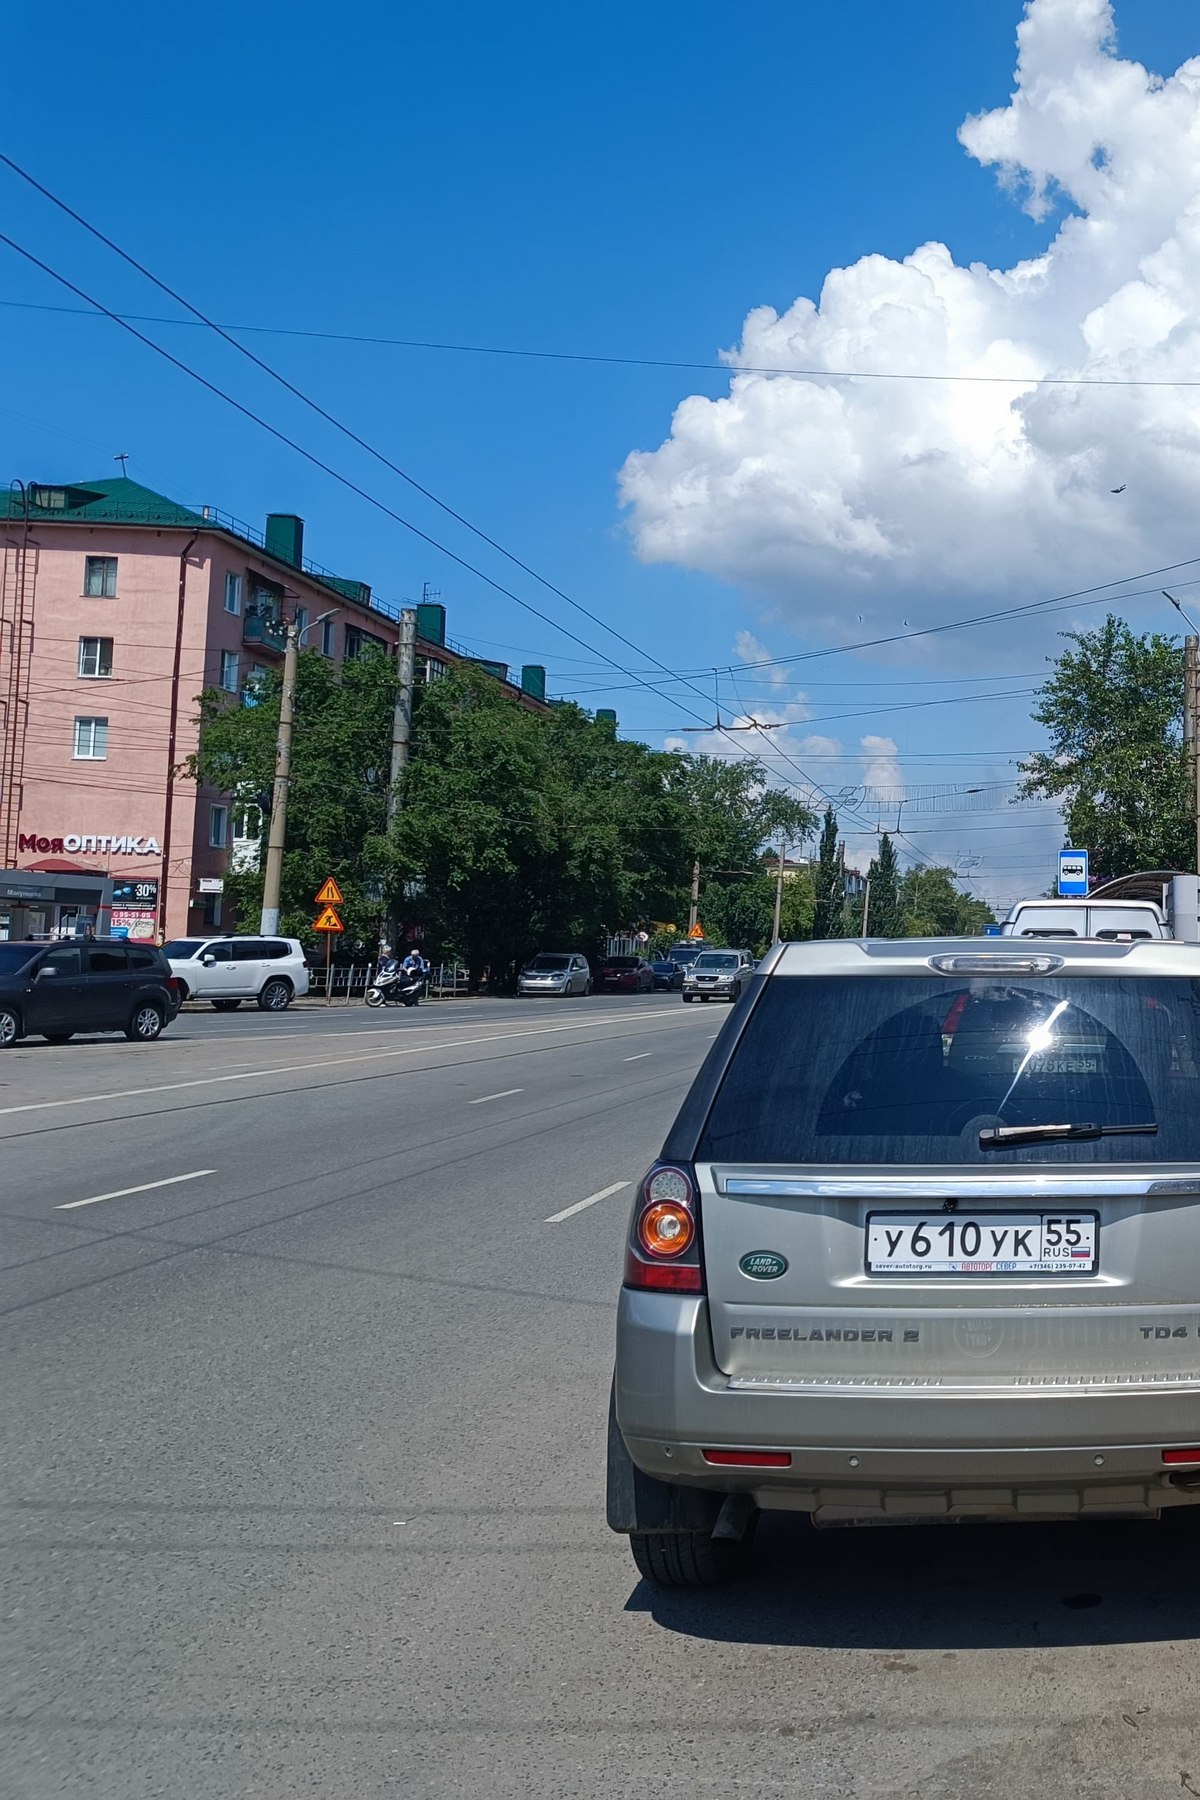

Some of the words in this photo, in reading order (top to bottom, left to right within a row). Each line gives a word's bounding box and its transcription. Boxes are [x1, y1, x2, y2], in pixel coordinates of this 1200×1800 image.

[1046, 1219, 1082, 1246] 55
[1043, 1248, 1070, 1257] RUS
[730, 1326, 893, 1343] FREELANDER
[903, 1328, 920, 1343] 2
[1139, 1325, 1188, 1339] TD4
